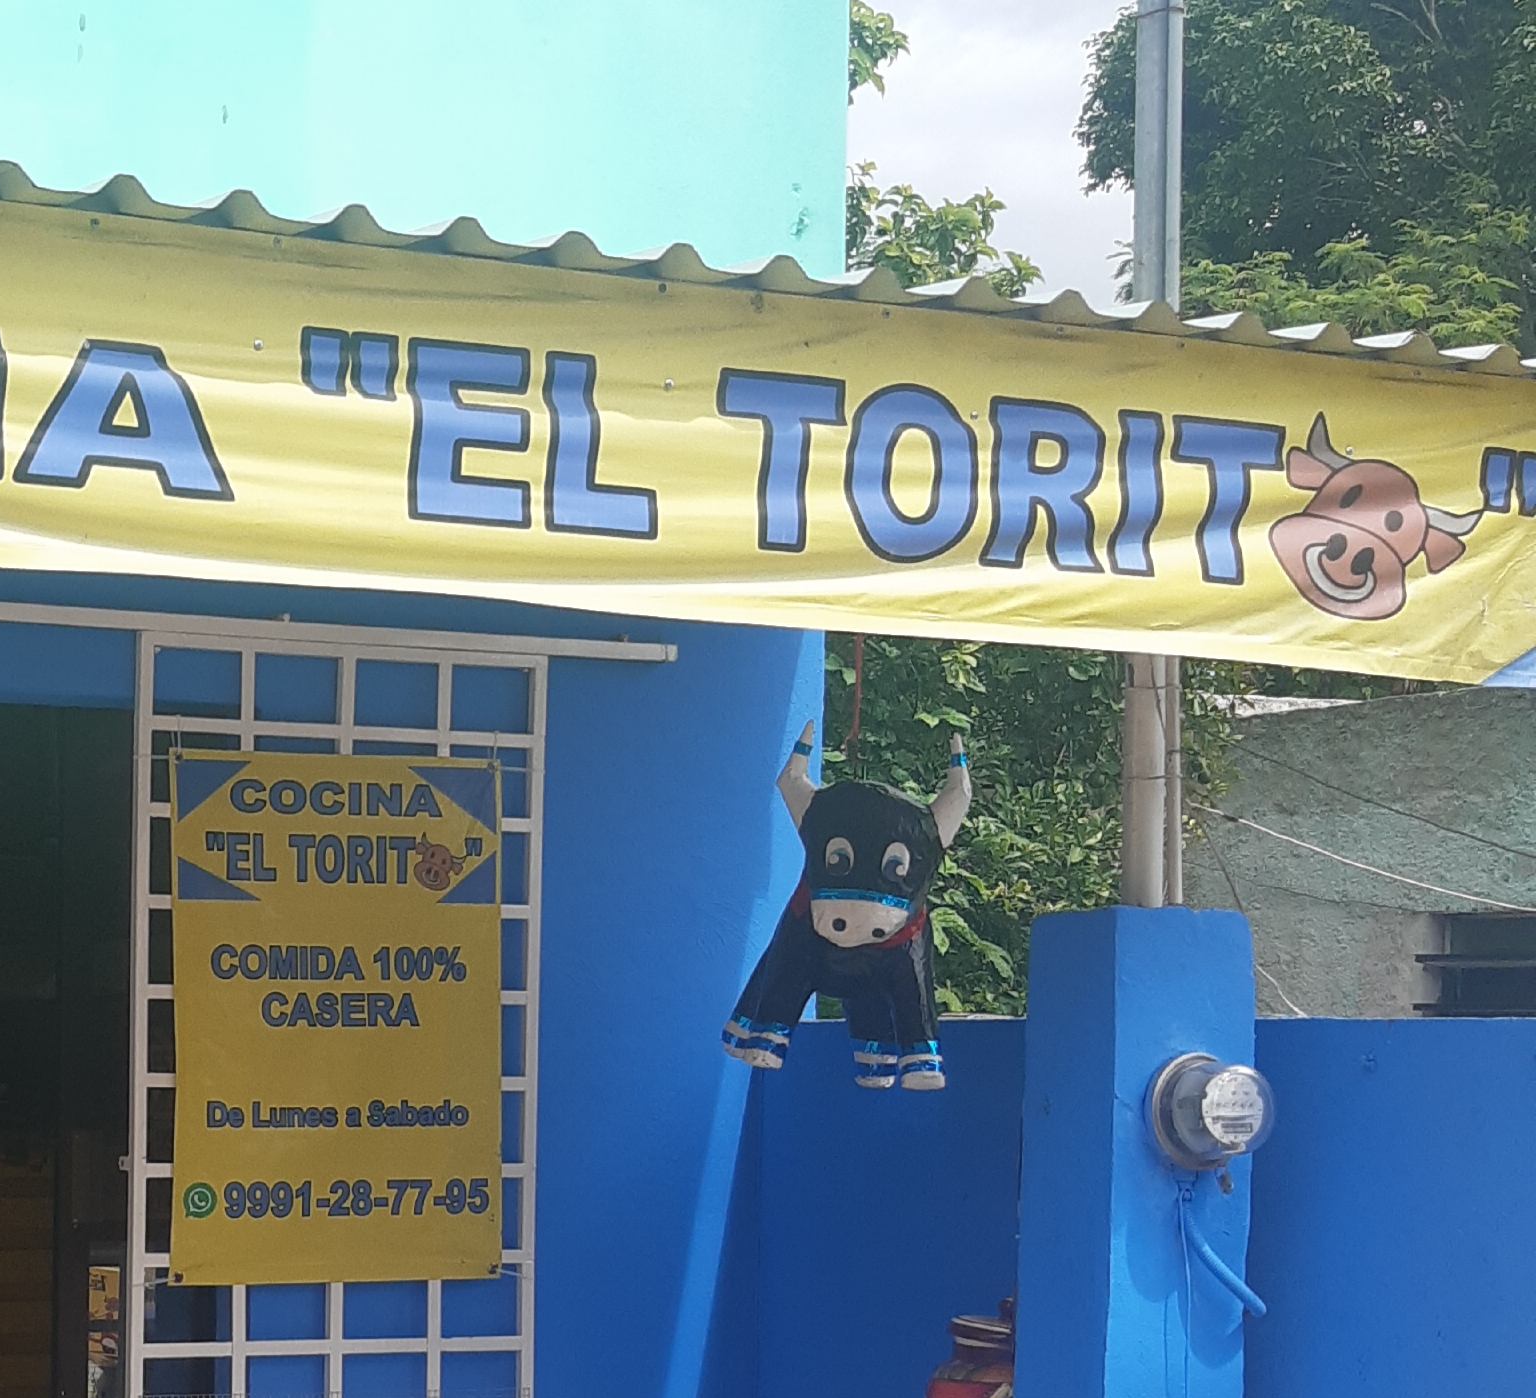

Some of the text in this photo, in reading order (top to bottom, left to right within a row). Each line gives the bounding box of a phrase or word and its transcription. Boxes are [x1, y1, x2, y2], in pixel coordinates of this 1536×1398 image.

[301, 326, 658, 539] "EL
[230, 779, 442, 818] COCINA
[205, 831, 277, 882] "EL
[210, 943, 467, 982] COMIDA 100%
[262, 992, 420, 1027] CASERA
[207, 1100, 469, 1128] De Lunes a Sabado
[224, 1179, 489, 1219] 9991-28-77-95
